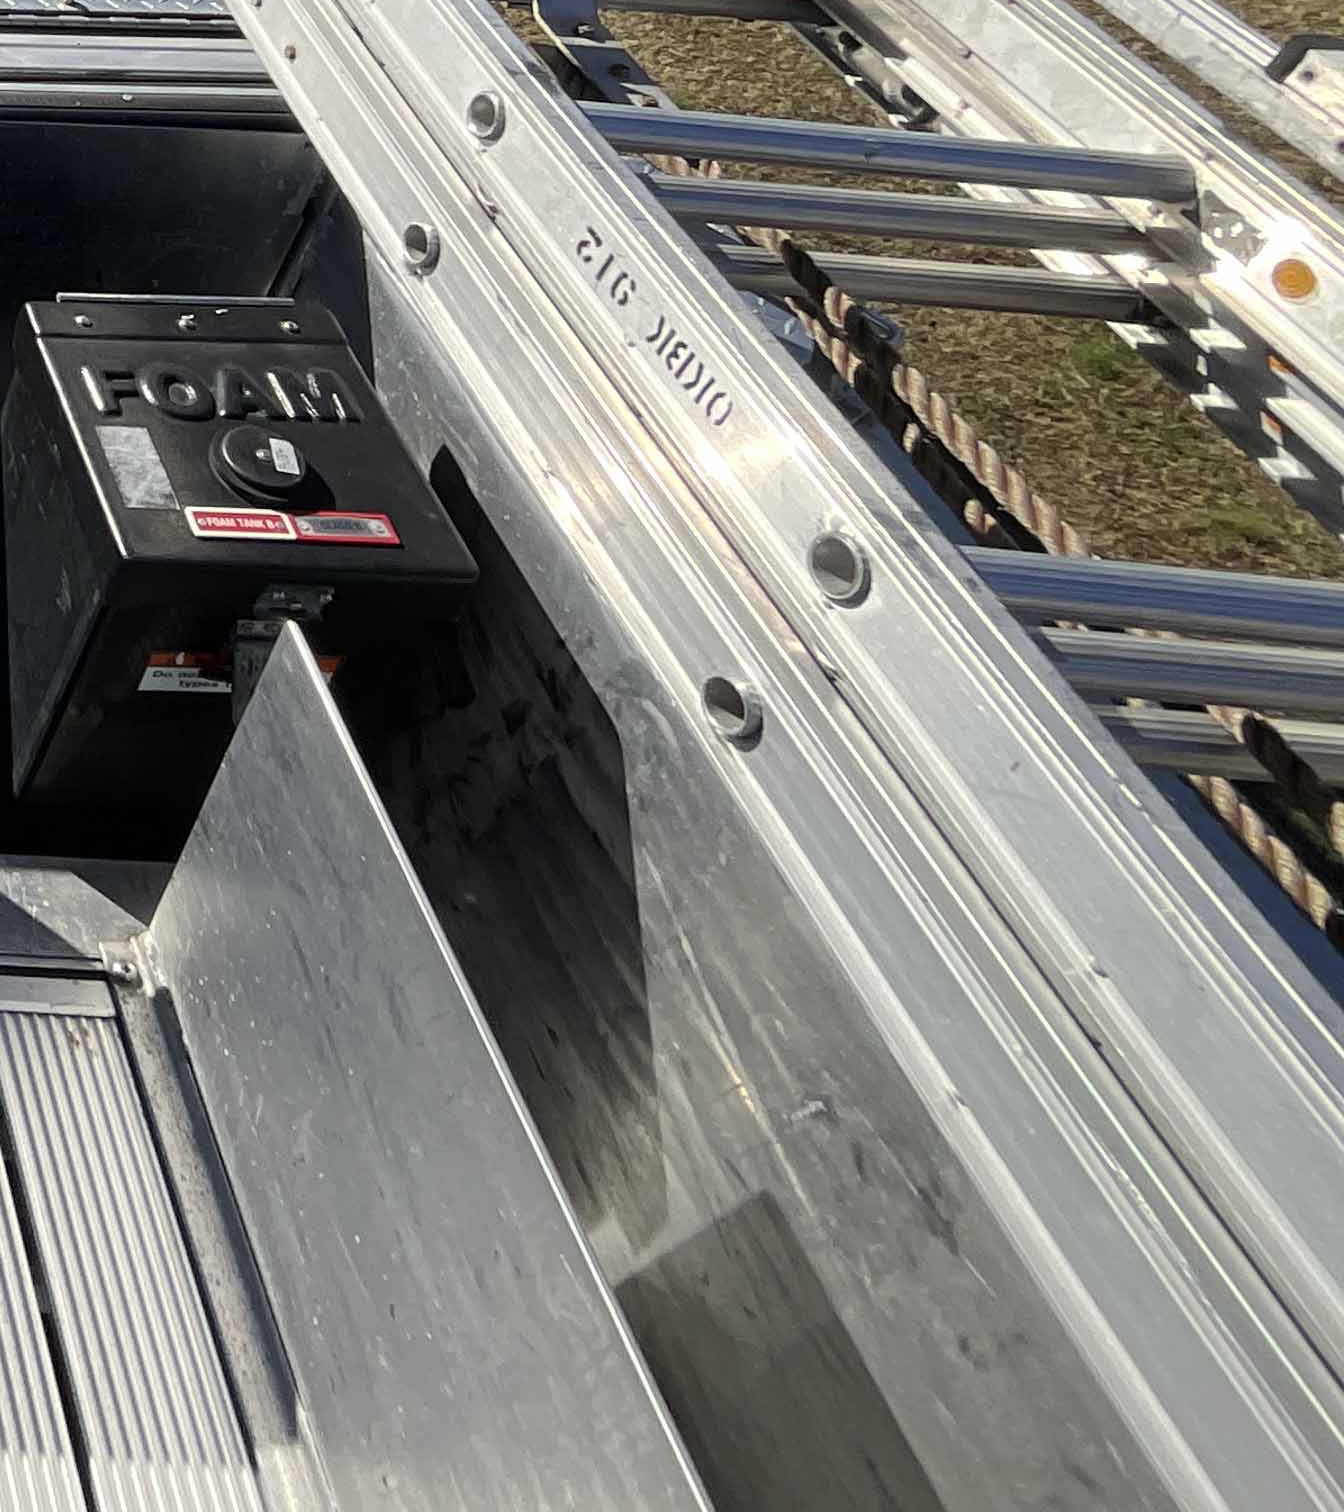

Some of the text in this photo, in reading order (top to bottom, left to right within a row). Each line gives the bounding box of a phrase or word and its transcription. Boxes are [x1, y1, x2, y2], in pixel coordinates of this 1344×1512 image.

[575, 226, 636, 306] 912
[81, 363, 362, 422] FOAM
[206, 517, 236, 527] FOAM
[237, 518, 264, 529] TANK
